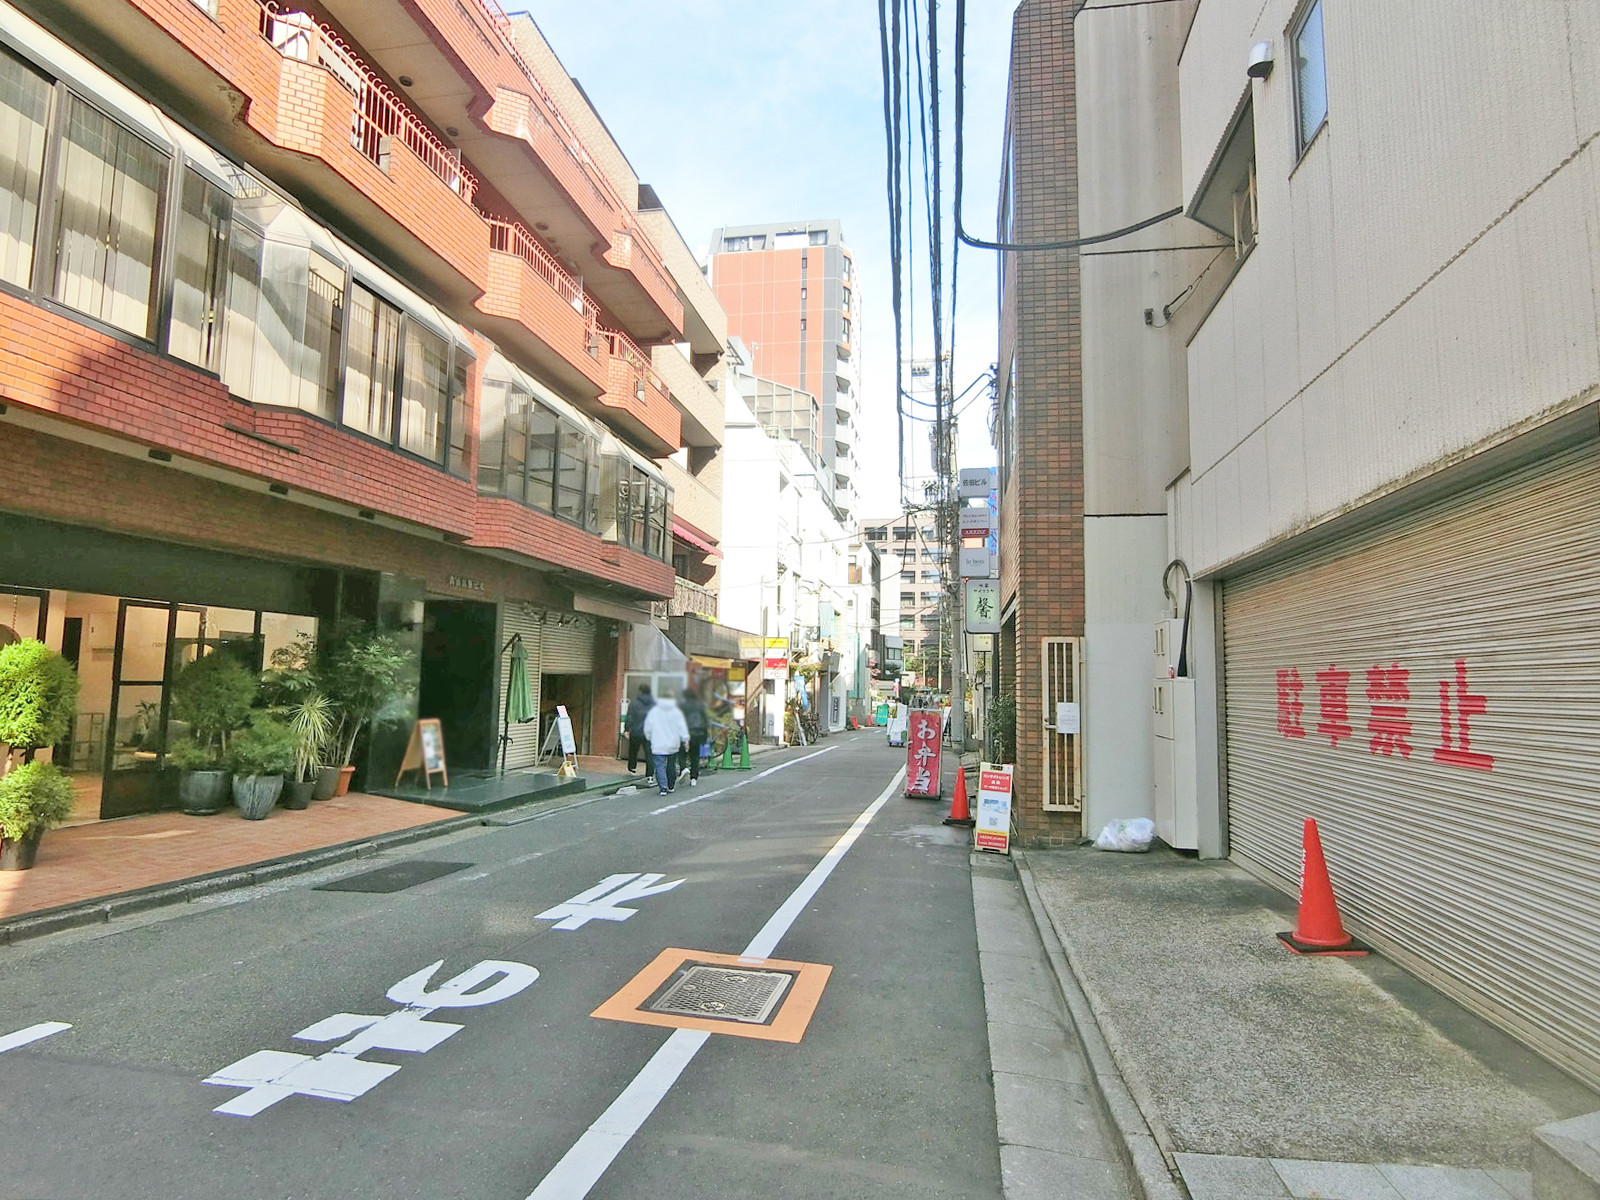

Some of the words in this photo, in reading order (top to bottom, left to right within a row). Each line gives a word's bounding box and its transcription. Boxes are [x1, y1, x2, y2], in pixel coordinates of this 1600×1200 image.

[914, 718, 937, 791] お弁当
[1276, 657, 1494, 772] 駐車禁止
